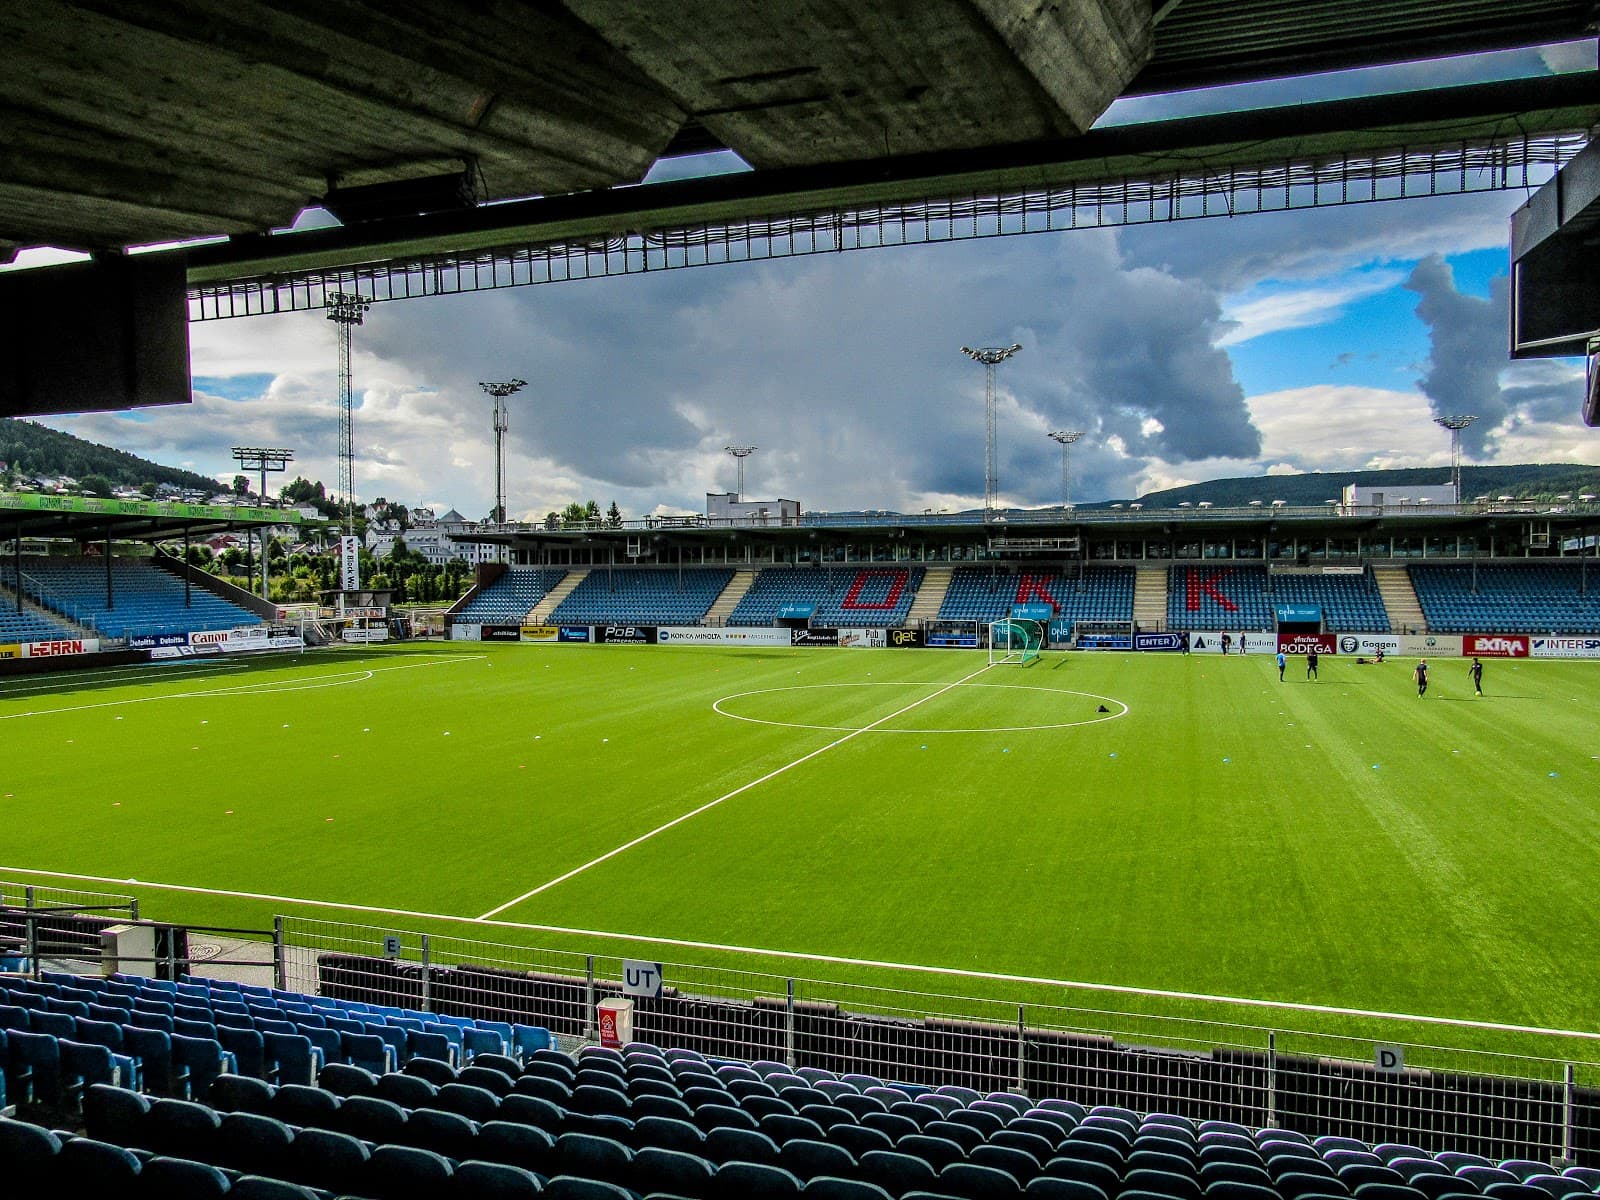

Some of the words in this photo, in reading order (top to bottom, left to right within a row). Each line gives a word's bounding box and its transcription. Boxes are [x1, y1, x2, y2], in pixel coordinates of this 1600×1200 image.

[192, 633, 228, 643] Canon
[871, 639, 886, 648] Bar
[1281, 643, 1332, 654] BODEGA
[1362, 640, 1397, 650] Goggen
[1475, 638, 1525, 656] EXTRA
[387, 939, 396, 953] E
[626, 968, 655, 989] UT
[1380, 1050, 1397, 1068] D
